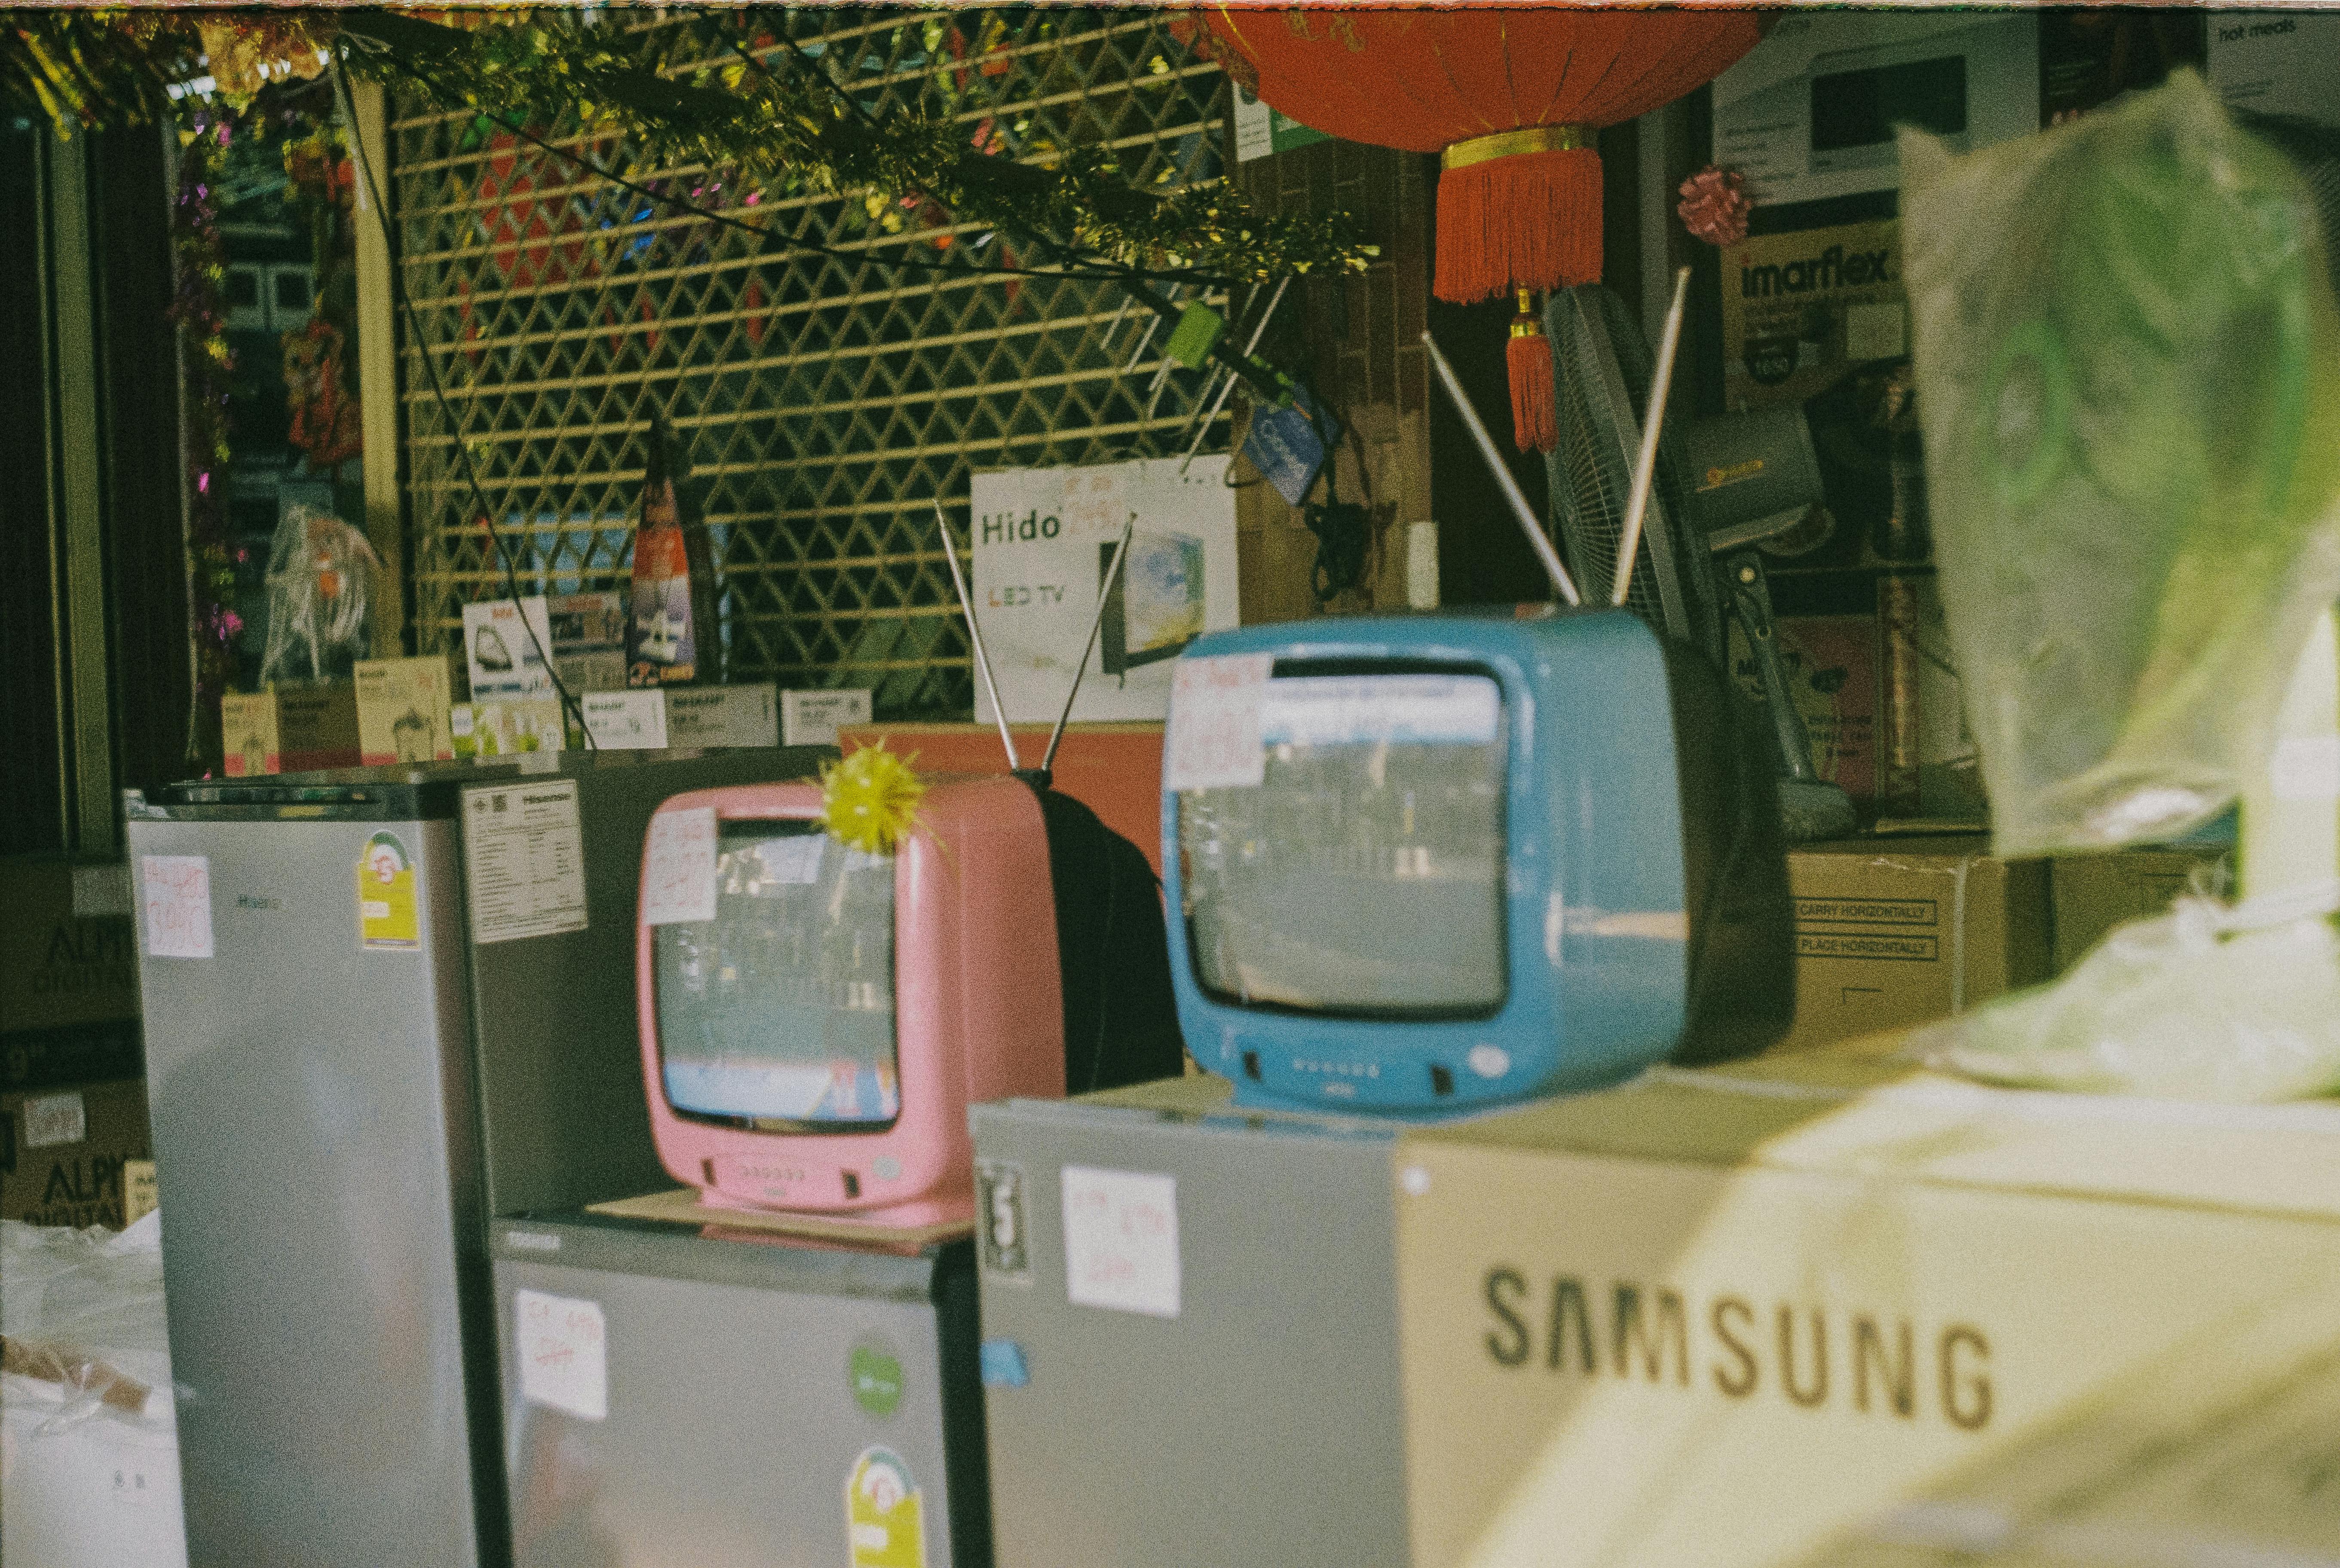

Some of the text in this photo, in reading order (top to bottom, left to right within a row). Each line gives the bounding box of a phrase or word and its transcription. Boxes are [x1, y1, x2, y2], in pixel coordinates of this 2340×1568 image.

[2220, 19, 2296, 42] hot meals
[1742, 246, 1889, 296] imarflex
[983, 510, 1060, 544] Hido
[988, 584, 1065, 608] LED TV
[1799, 902, 1925, 919] CARRY HORIZONTALLY
[1801, 938, 1927, 956] PLACE HORIZONTALLY
[1481, 1263, 1994, 1432] SAMSUNG
